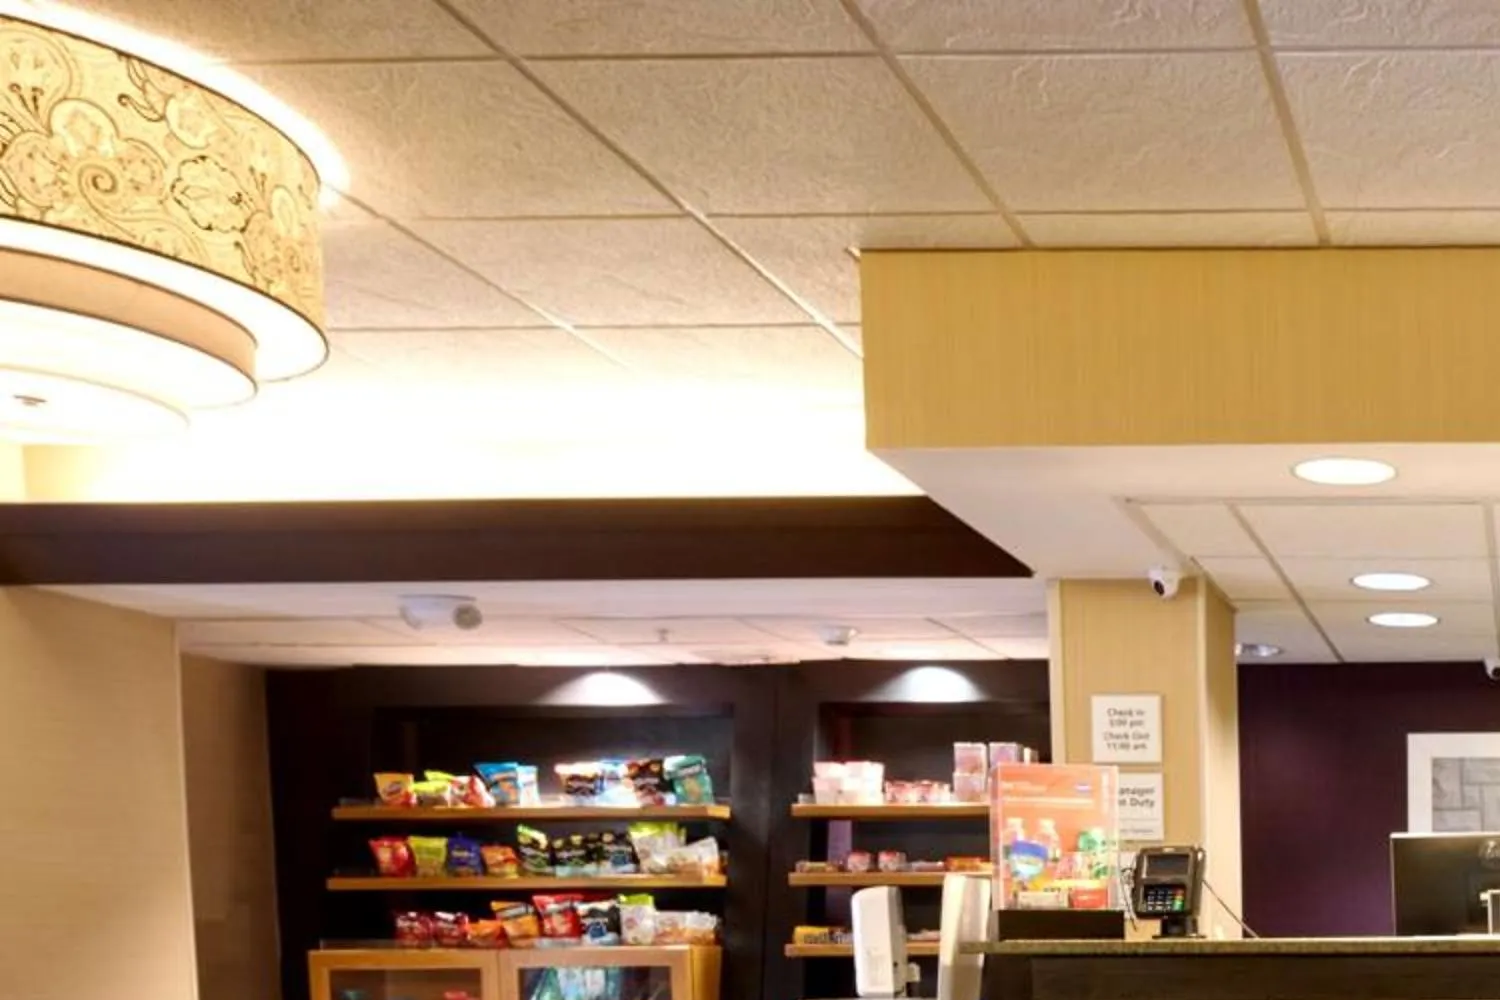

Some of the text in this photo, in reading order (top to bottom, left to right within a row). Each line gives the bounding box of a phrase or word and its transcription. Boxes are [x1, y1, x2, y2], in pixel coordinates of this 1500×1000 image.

[1106, 707, 1133, 717] Check
[1103, 731, 1130, 741] Check
[1119, 787, 1155, 797] anager
[1130, 797, 1155, 808] Duty
